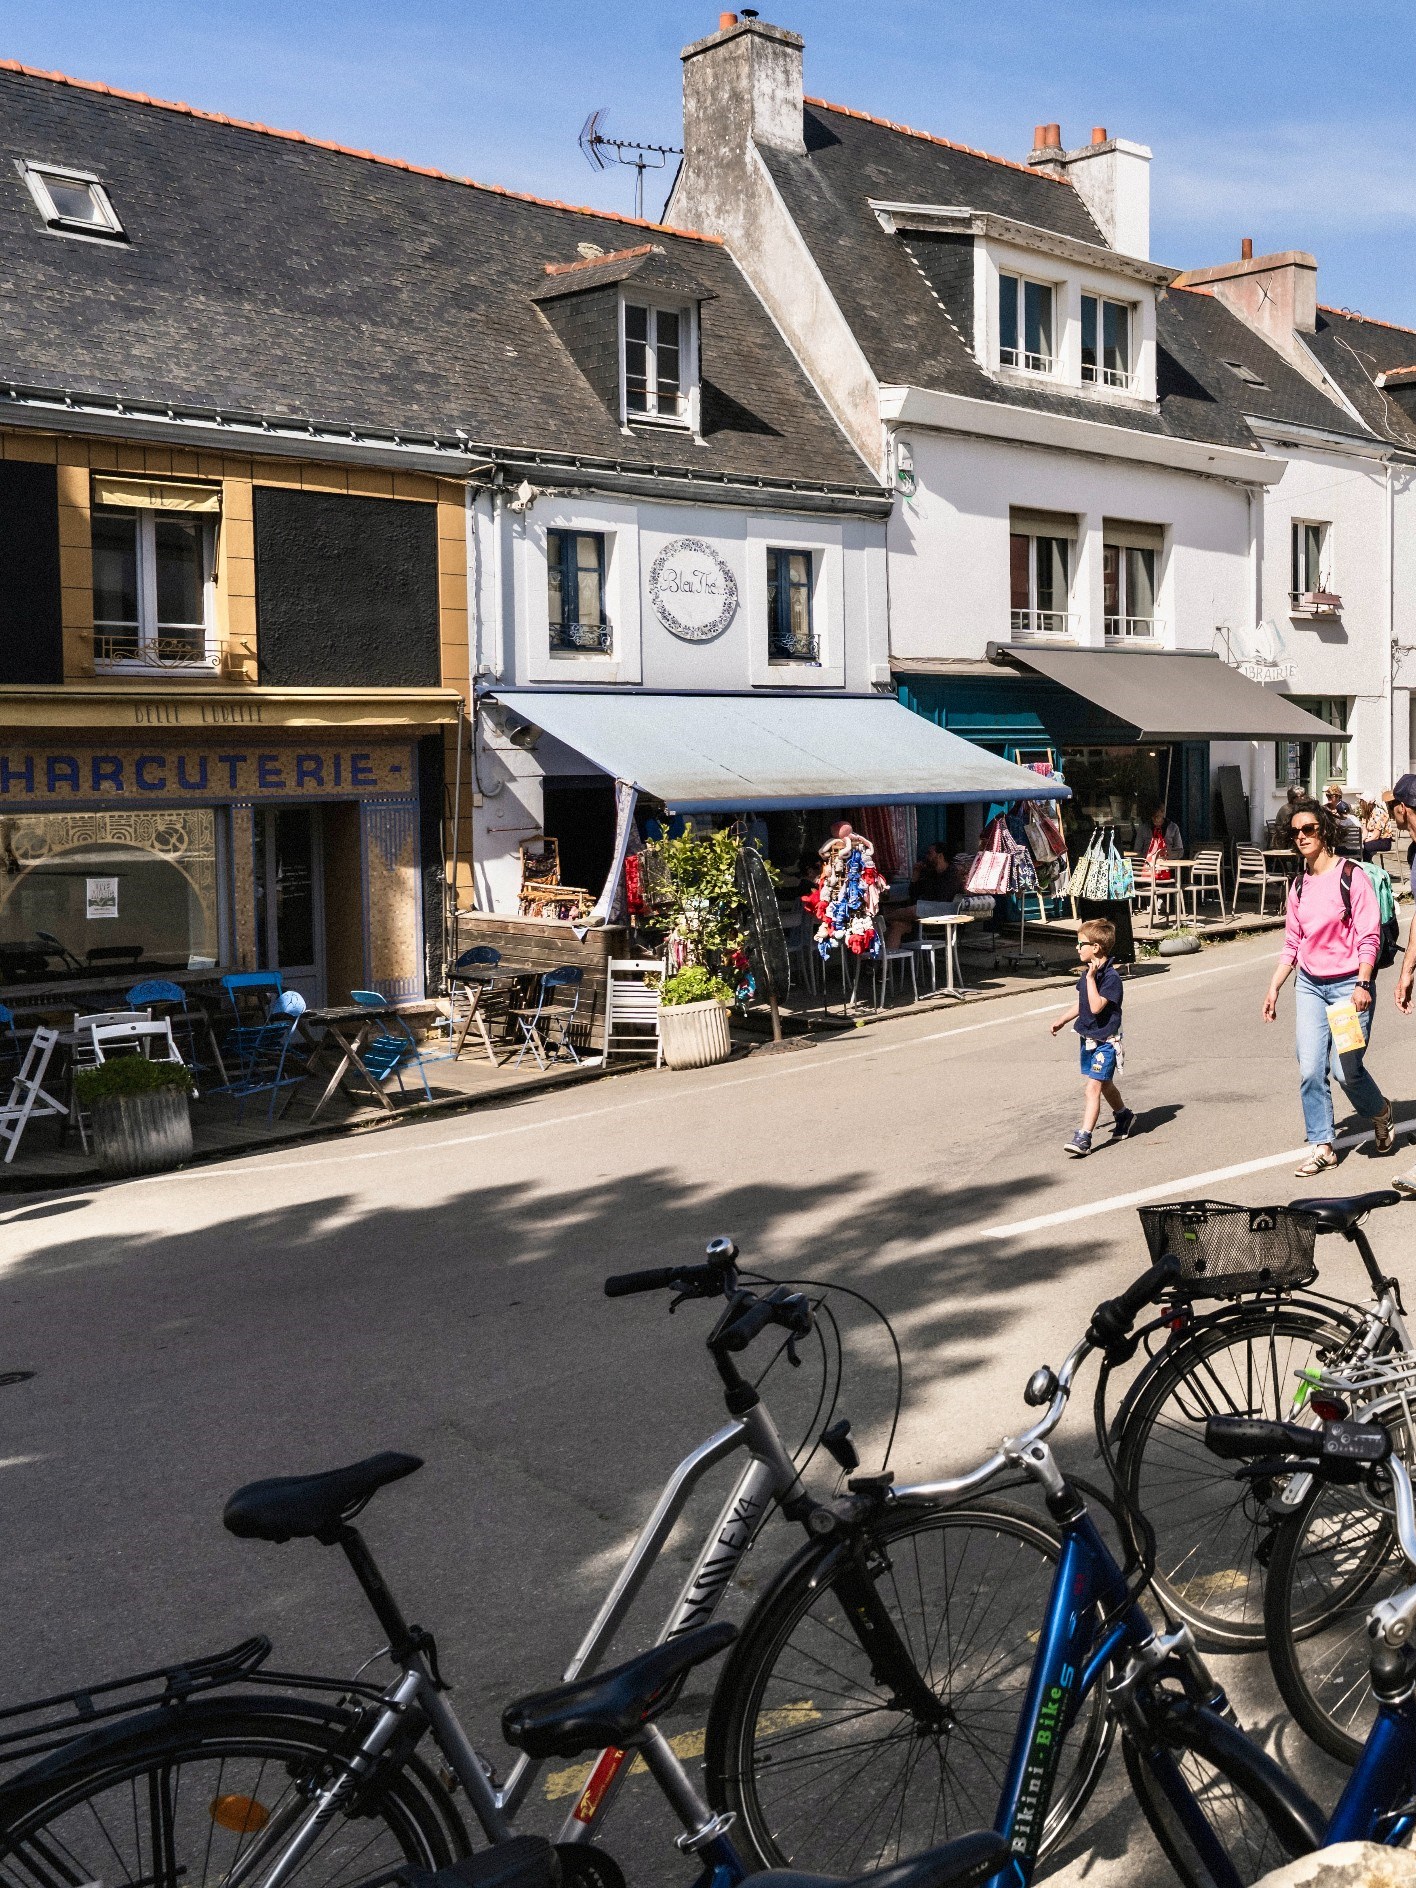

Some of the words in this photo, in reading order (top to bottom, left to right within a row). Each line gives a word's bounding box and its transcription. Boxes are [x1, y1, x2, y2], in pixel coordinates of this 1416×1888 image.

[660, 568, 694, 593] Bleu
[1244, 665, 1298, 681] IBRAIRIE
[718, 1495, 761, 1550] EX4
